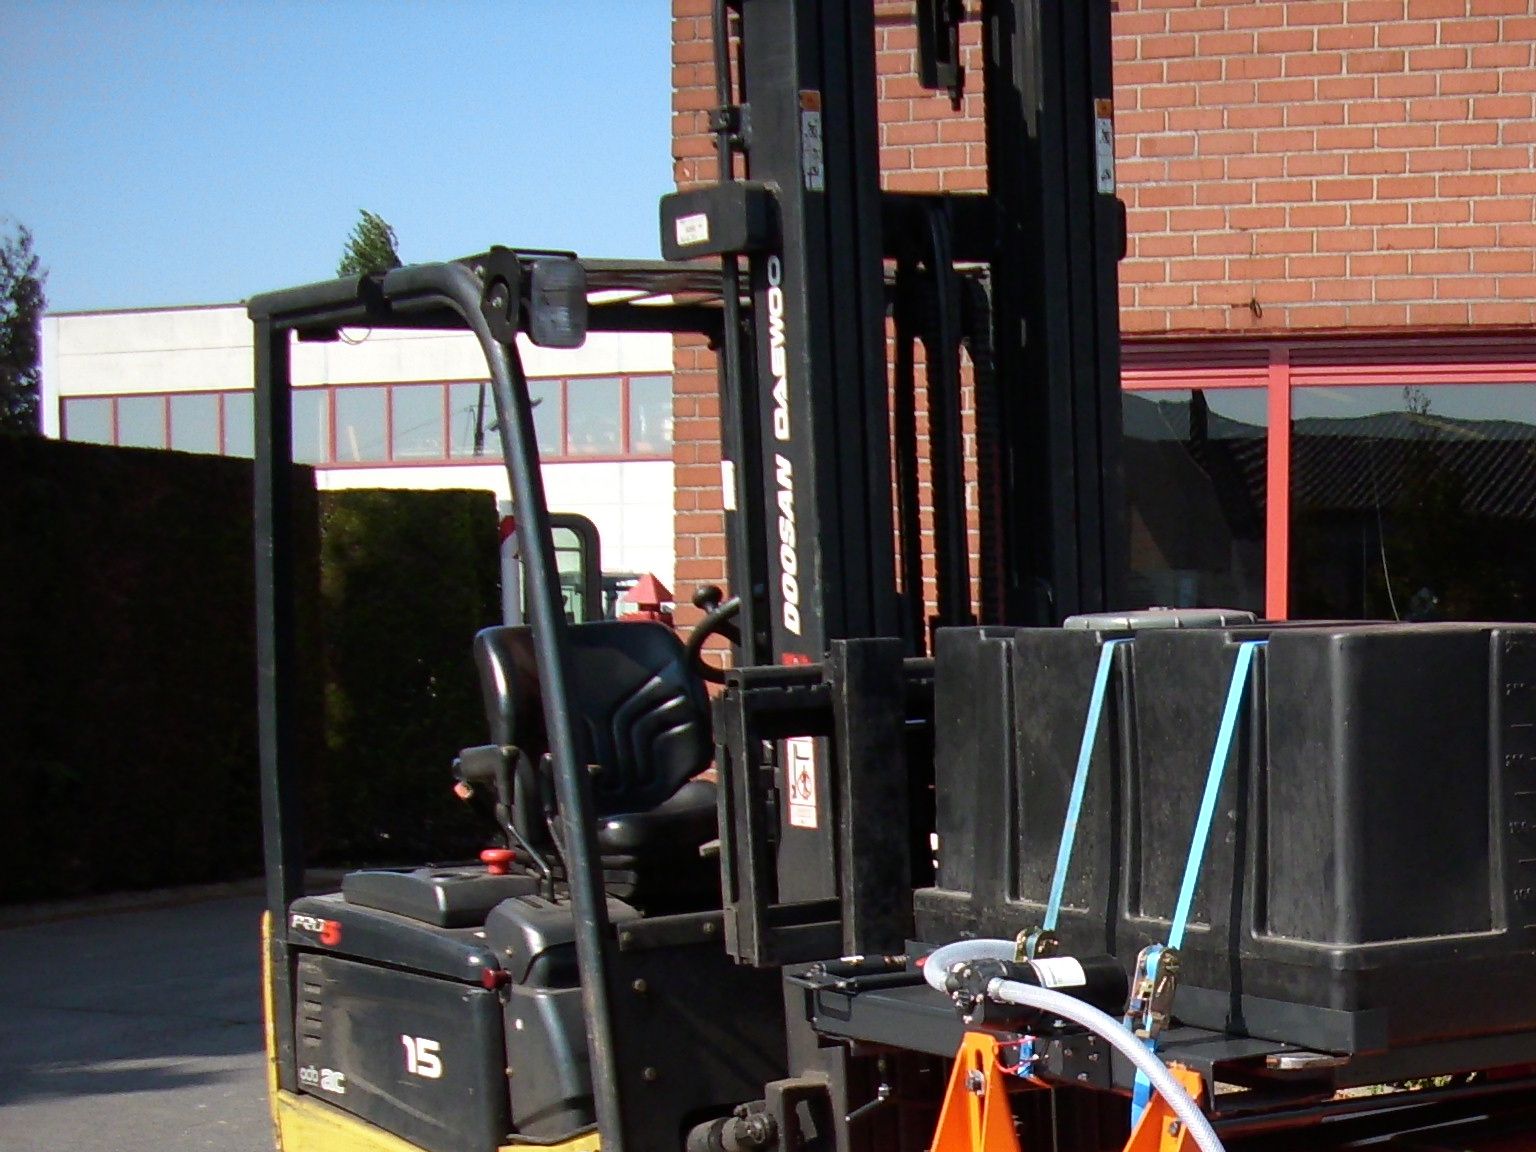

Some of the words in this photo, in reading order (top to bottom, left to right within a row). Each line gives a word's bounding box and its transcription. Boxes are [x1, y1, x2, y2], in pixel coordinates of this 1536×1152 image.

[767, 254, 791, 441] DAEWOO
[776, 453, 801, 636] DOOSAN
[402, 1034, 443, 1079] 15
